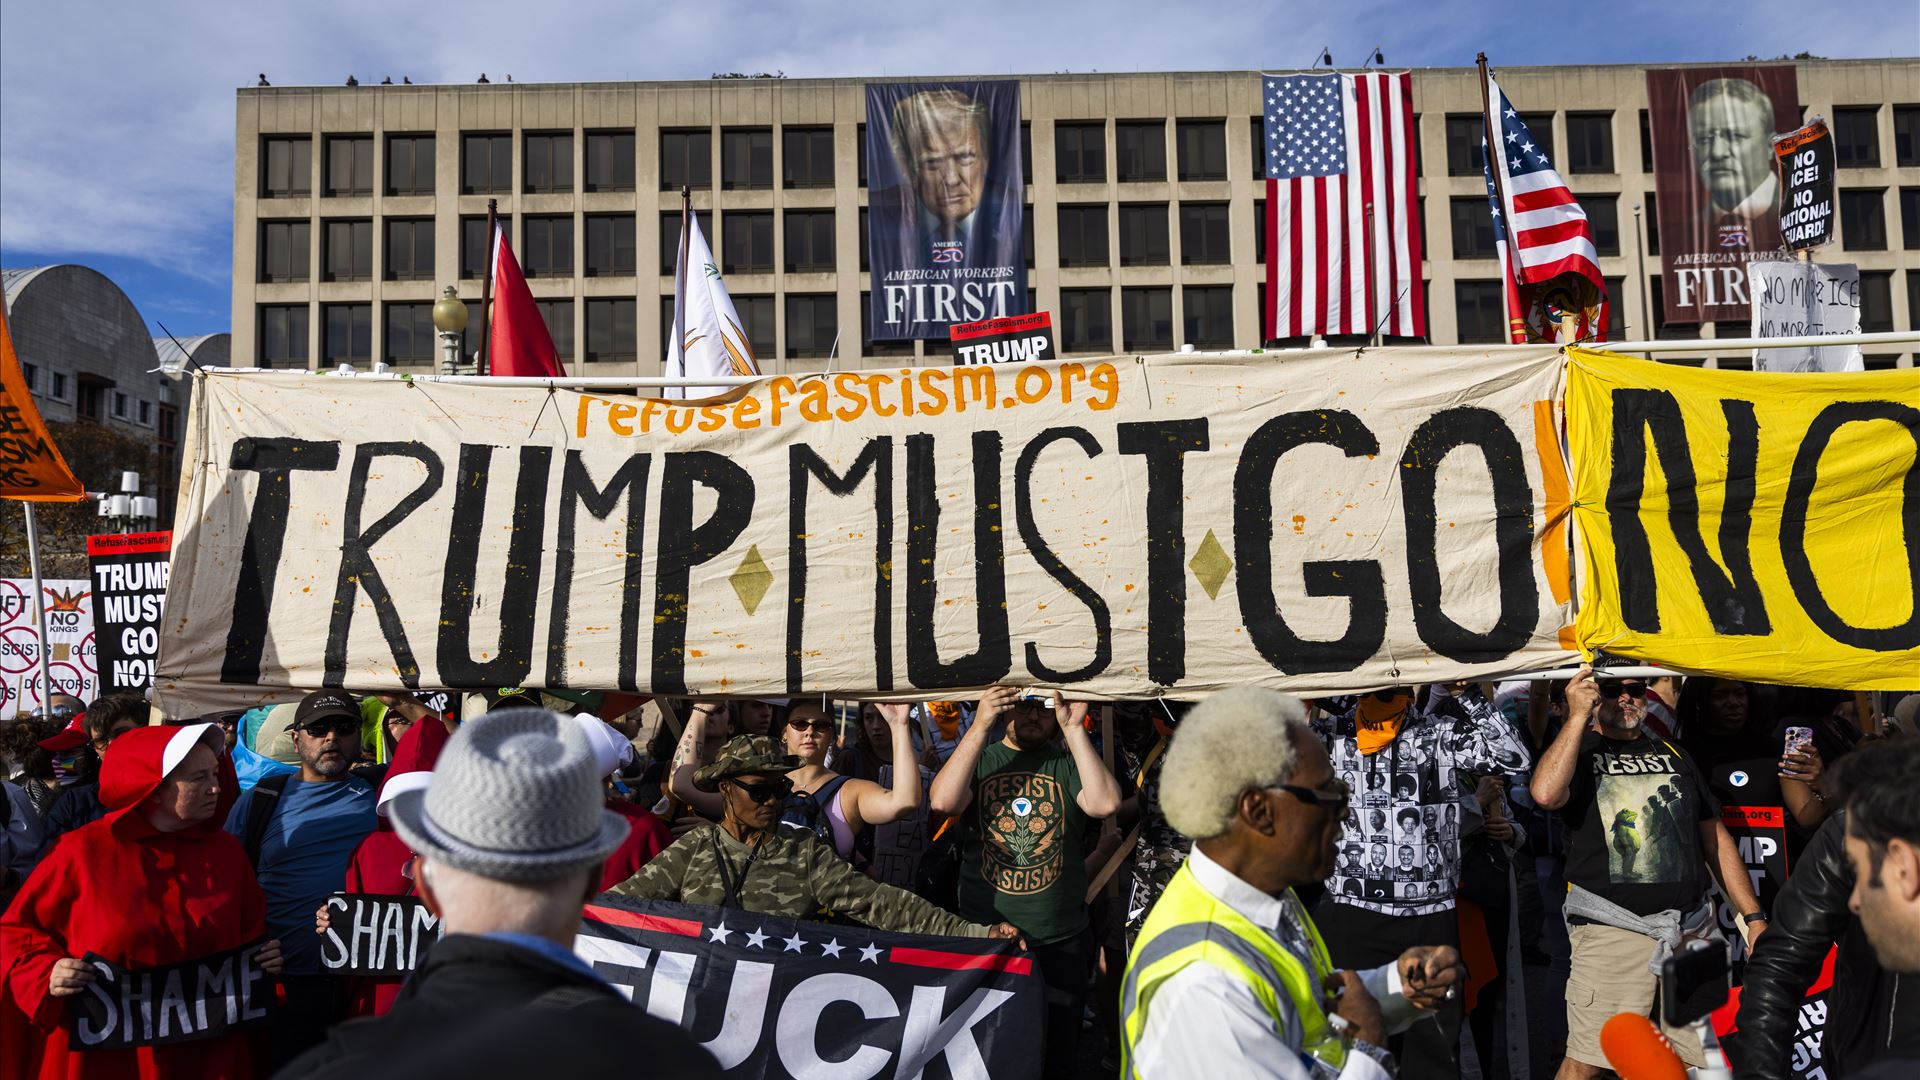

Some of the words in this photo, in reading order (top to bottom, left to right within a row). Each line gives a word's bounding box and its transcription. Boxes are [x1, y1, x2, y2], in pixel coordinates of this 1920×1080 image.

[1793, 149, 1816, 170] NO
[1790, 164, 1819, 188] ICE!
[1793, 189, 1814, 209] NO
[1781, 200, 1832, 232] NATIONAL
[1785, 218, 1825, 243] GUARD!
[932, 248, 964, 263] 250
[1674, 252, 1738, 265] AMERICAN
[883, 268, 951, 282] AMERICAN
[953, 266, 1014, 280] WORKERS
[1673, 266, 1751, 307] FIR
[883, 281, 1016, 324] FIRST
[1763, 276, 1786, 305] NO
[1827, 278, 1861, 308] ICE
[957, 315, 1043, 335] RefuseFascism.org
[958, 336, 1048, 366] TRUMP
[1605, 387, 1920, 652] NO
[94, 535, 169, 548] RefuseFascism.org
[220, 436, 757, 694] TRUMP
[786, 418, 1210, 692] MUST
[95, 561, 170, 592] TRUMP
[51, 613, 80, 625] NO
[104, 594, 166, 624] MUST
[121, 626, 158, 656] GO
[983, 775, 1056, 807] RESIST
[985, 853, 1061, 891] FASCISM
[321, 897, 446, 971] SHAM
[78, 941, 268, 1046] SHAME
